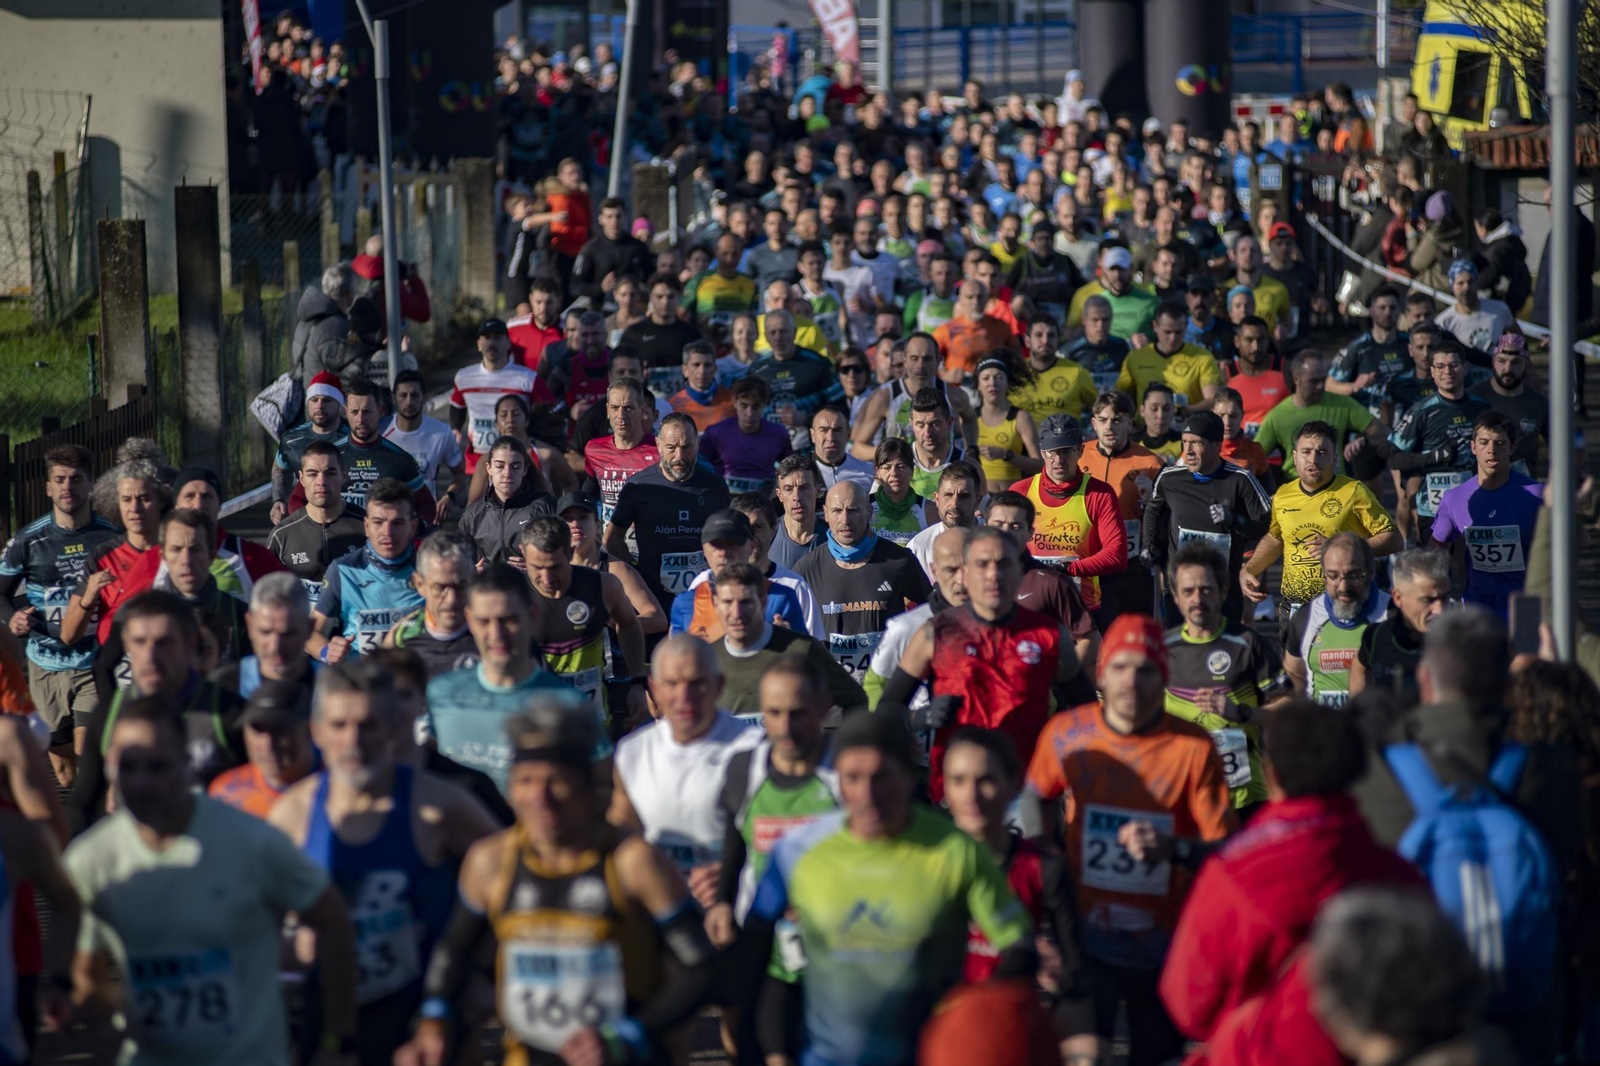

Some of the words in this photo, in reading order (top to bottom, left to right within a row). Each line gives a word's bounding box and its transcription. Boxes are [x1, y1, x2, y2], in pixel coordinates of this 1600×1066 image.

[1430, 476, 1451, 485] XXII
[654, 525, 676, 534] Alán
[1468, 528, 1493, 540] XXII
[1471, 543, 1517, 563] 357
[663, 555, 689, 567] XXII
[361, 612, 391, 626] XXII
[832, 636, 858, 650] XXII
[1321, 660, 1344, 670] home
[136, 980, 229, 1030] 278
